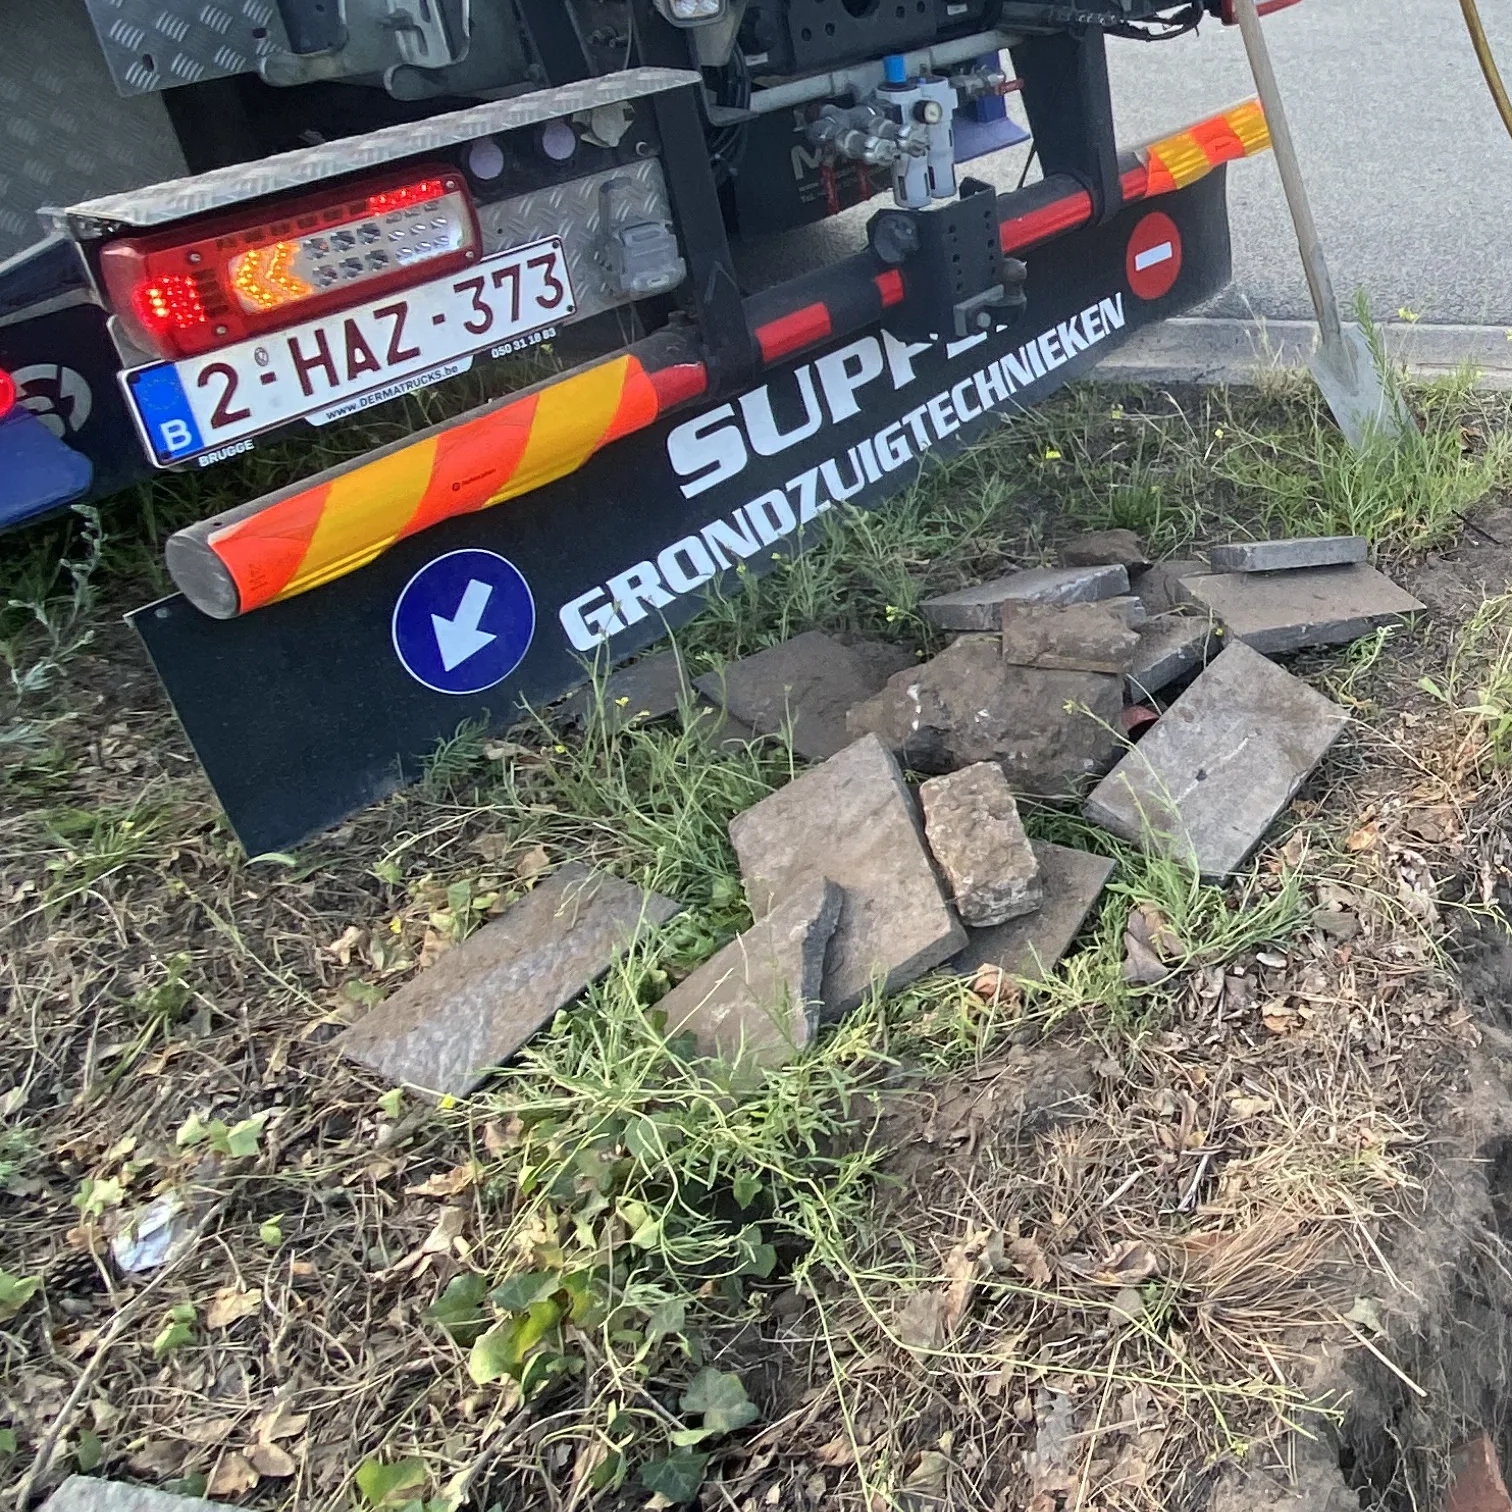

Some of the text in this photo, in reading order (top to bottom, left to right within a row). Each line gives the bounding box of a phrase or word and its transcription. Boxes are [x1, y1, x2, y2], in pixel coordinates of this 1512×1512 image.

[491, 343, 512, 358] 050
[325, 363, 459, 421] www.DERMATRUCKS.be
[160, 418, 192, 452] B
[198, 439, 255, 468] BRUGGE
[558, 292, 1126, 653] GRONDZUIGTECHNIEKEN
